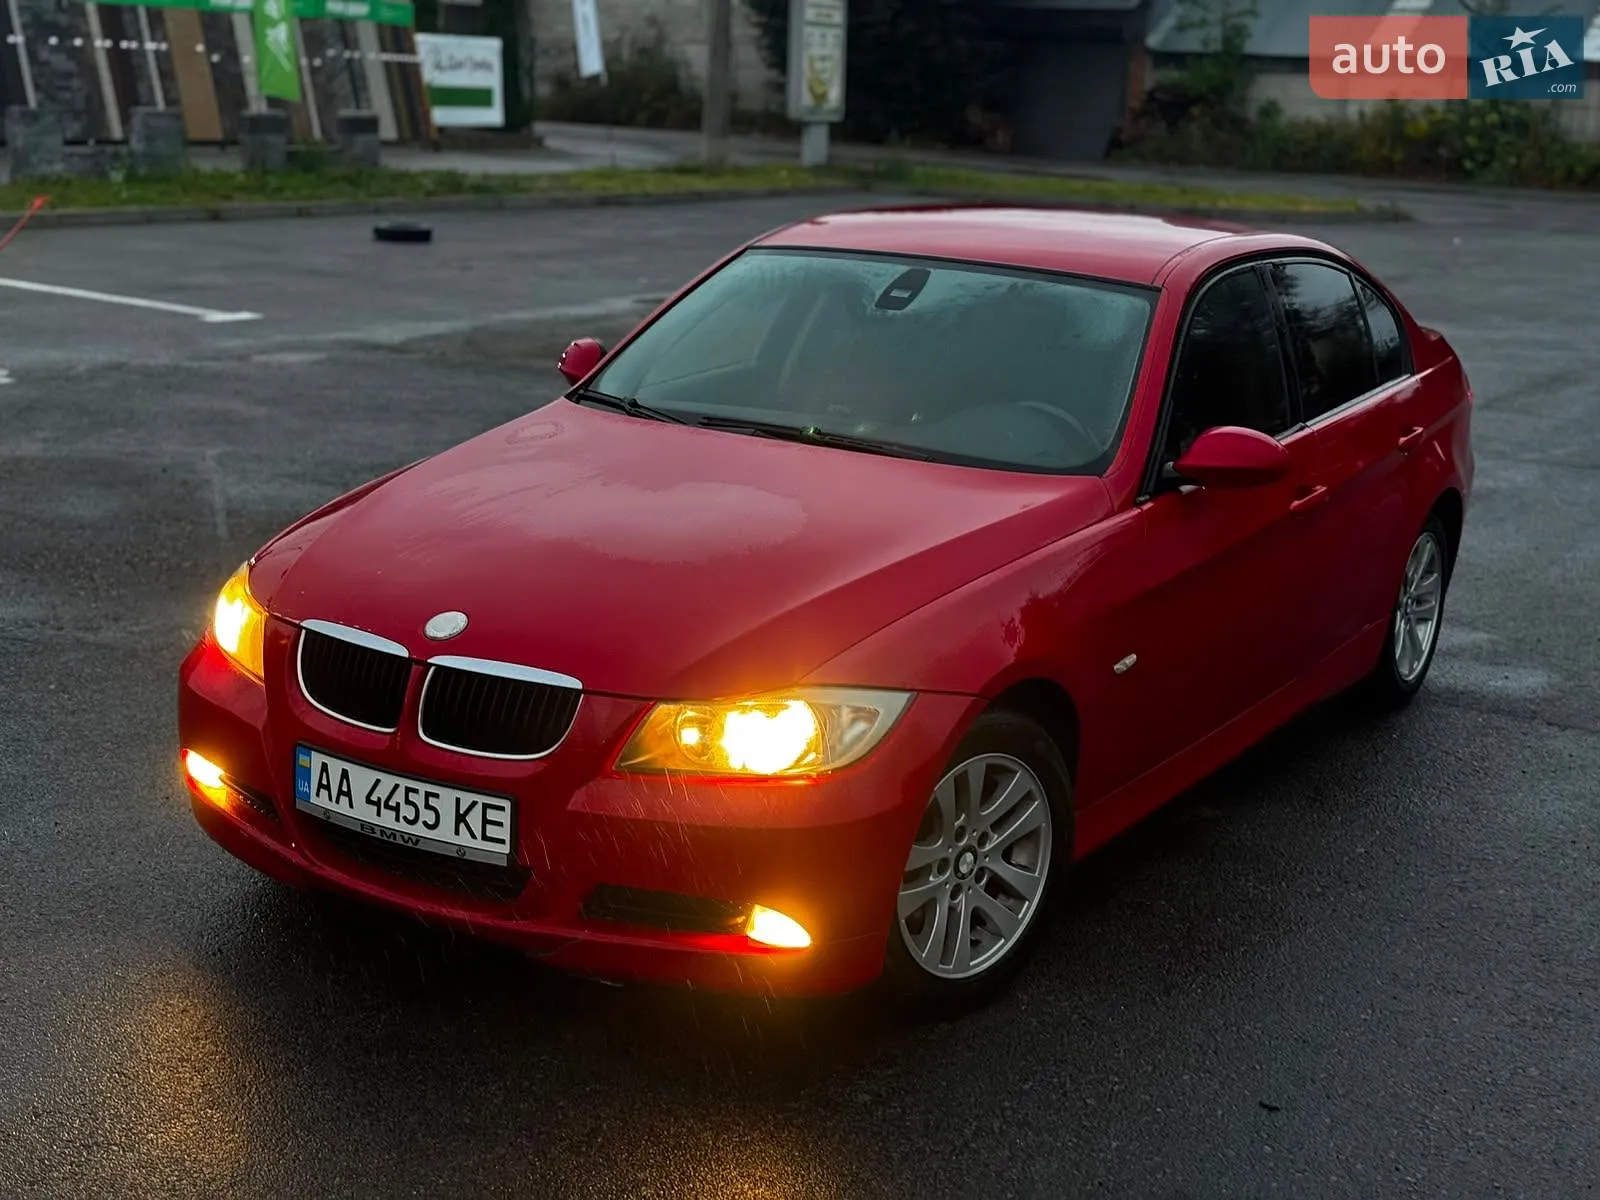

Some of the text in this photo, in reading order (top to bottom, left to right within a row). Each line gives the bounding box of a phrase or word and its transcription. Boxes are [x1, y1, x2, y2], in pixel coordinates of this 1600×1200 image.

[298, 779, 310, 793] UA
[316, 761, 506, 845] AA 4455 KE
[359, 823, 421, 846] BMW
